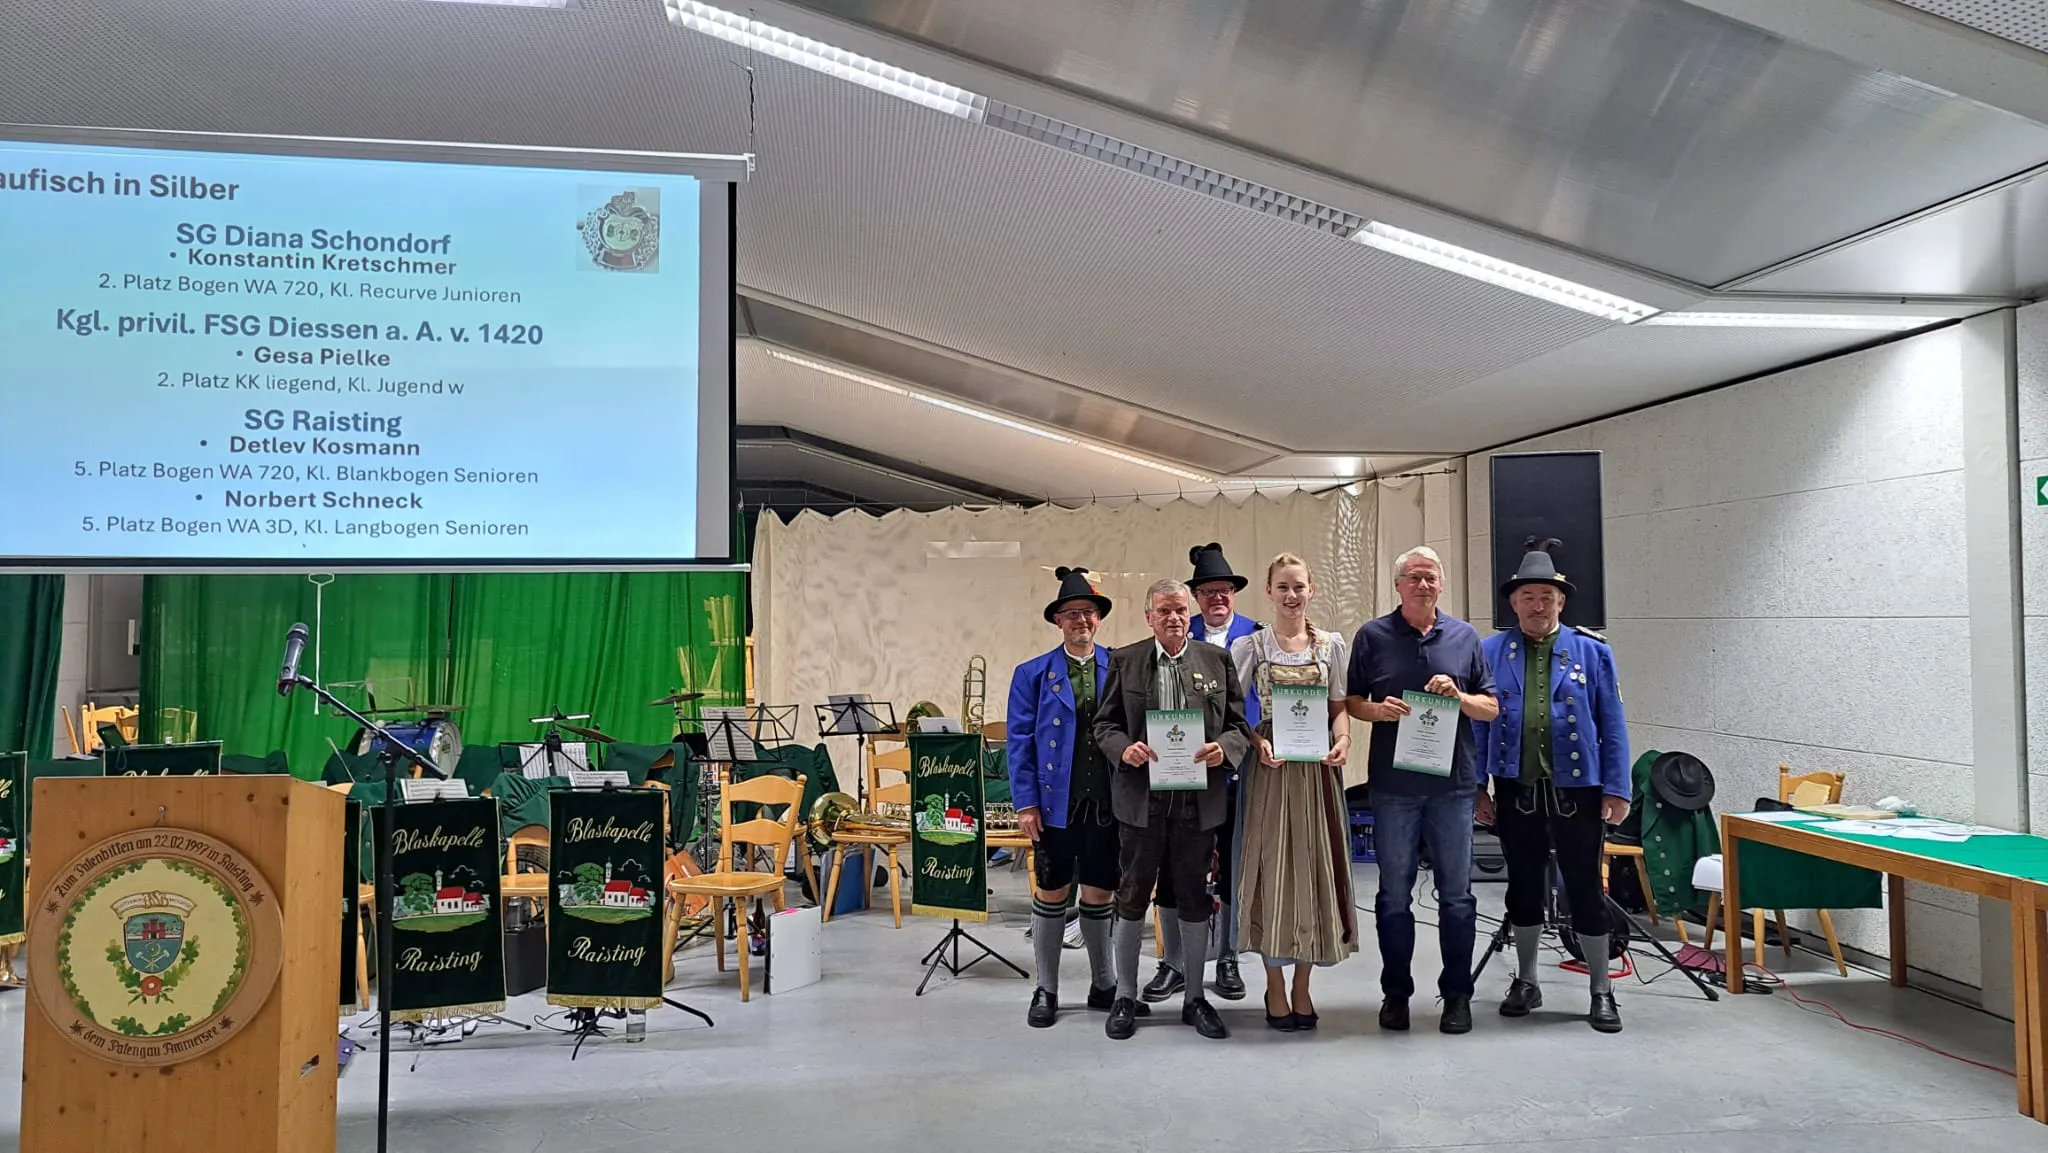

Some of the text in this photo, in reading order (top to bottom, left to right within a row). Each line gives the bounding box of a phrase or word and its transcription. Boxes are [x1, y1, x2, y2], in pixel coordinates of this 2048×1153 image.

[114, 172, 140, 196] in
[149, 174, 239, 200] Silber
[176, 223, 451, 255] SG Diana Schondorf
[189, 248, 456, 275] Konstantin Kretschmer
[99, 273, 520, 303] 2. Platz Bogen WA 720, Kl. Recurve Junioren
[57, 308, 543, 345] Kgl. privil. FSG Diessen a. A. v. 1420
[254, 346, 390, 367] Gesa Pielke
[157, 372, 464, 397] 2. Platz KK liegend, Kl. Jugend w
[244, 409, 402, 438] SG Raisting
[230, 436, 419, 456] Detlev Kosmann
[75, 461, 538, 486] 5. Platz Bogen WA 720, Kl. Blankbogen Senioren
[226, 490, 423, 510] Norbert Schneck
[82, 516, 528, 538] 5. Platz Bogen WA 3D, Kl. Langbogen Senioren
[1276, 688, 1321, 696] URKUNDE
[1407, 693, 1455, 708] URKUNDE
[1151, 713, 1197, 721] URKUNDE
[917, 754, 977, 779] Blaskapelle
[392, 825, 486, 856] Blaskapelle
[564, 815, 654, 844] Blaskapelle
[54, 874, 78, 898] Zum
[136, 838, 152, 849] am
[206, 849, 220, 862] in
[217, 853, 254, 892] Raisting
[921, 856, 975, 884] Raisting
[395, 947, 483, 973] Raisting
[567, 936, 647, 966] Raisting
[83, 1030, 105, 1048] dem
[163, 1026, 221, 1056] Ammersee
